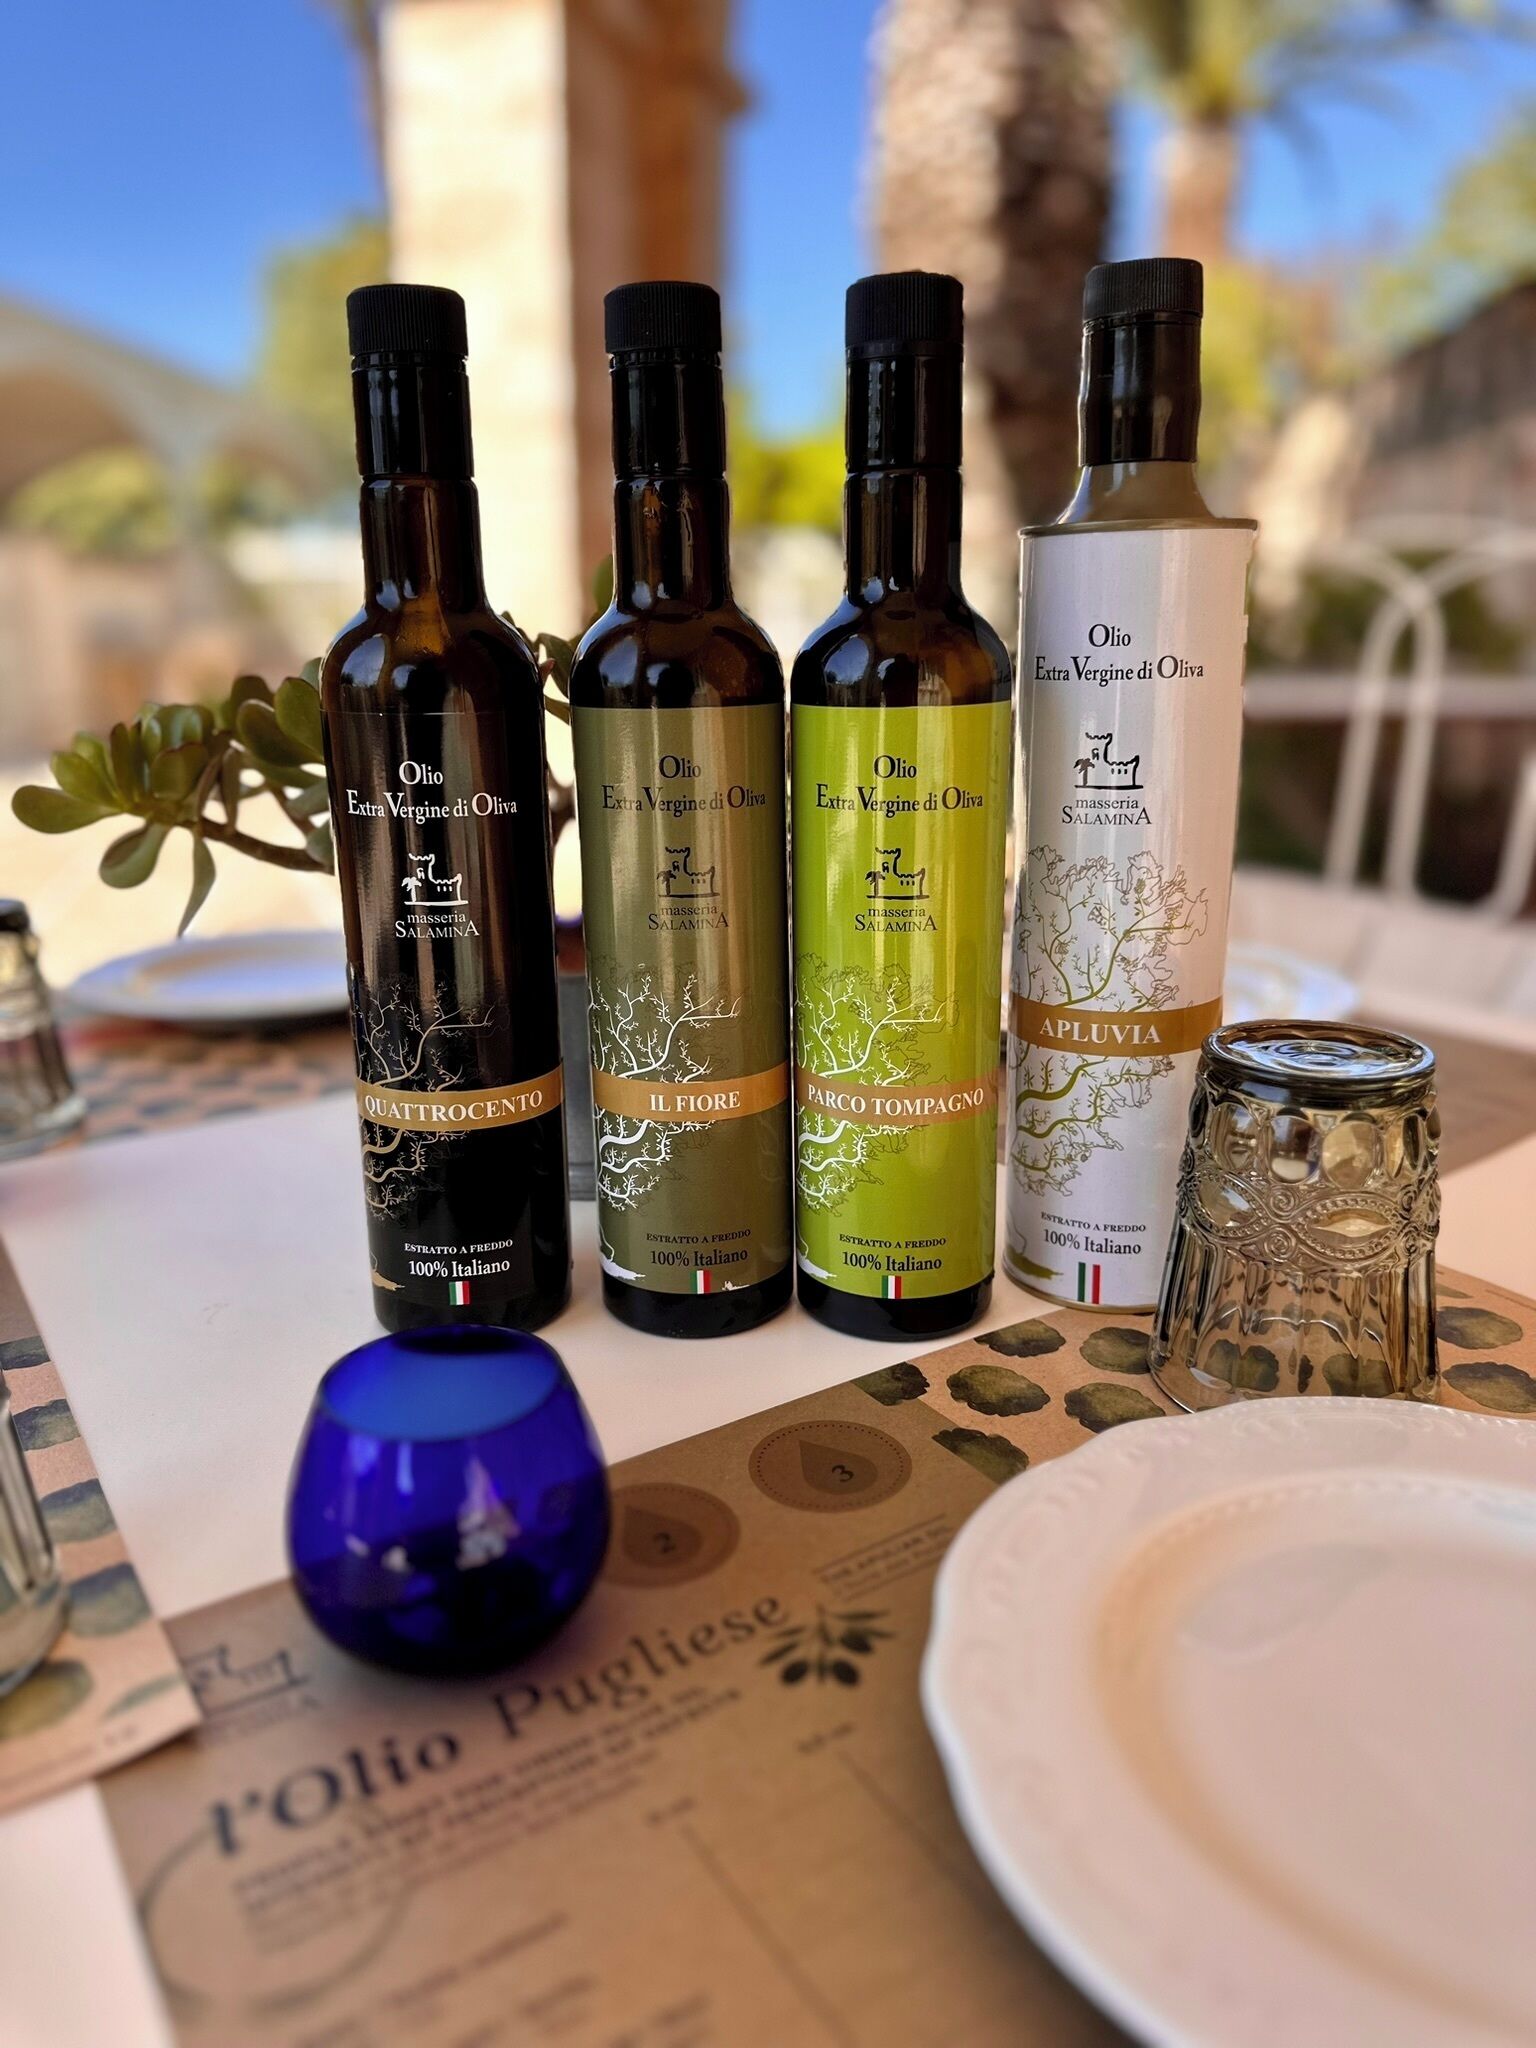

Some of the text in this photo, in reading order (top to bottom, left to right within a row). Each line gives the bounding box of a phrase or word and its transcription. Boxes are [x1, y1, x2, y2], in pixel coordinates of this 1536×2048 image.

[1088, 623, 1131, 647] Olio
[1034, 655, 1204, 687] Extra Vergine di Oliva
[399, 761, 444, 785] Olio
[659, 755, 702, 779] Olio
[874, 755, 917, 778] Olio
[346, 788, 517, 824] Extra Vergine di Oliva
[601, 784, 766, 817] Extra Vergine di Oliva
[816, 783, 984, 818] Extra Vergine di Oliva
[1076, 796, 1139, 809] masseria
[1062, 805, 1152, 826] SALAMINA
[407, 911, 466, 923] masseria
[660, 903, 718, 916] masseria
[868, 906, 926, 917] masseria
[395, 920, 480, 938] SALAMINA
[648, 912, 729, 931] SALAMINA
[855, 913, 938, 932] SALAMINA
[1039, 1017, 1163, 1044] APLUVIA
[364, 1089, 543, 1122] QUATTROCENTO
[650, 1091, 741, 1113] IL FIORE
[807, 1084, 984, 1116] PARCO TOMPAGNO
[1040, 1211, 1147, 1232] ESTRATTO A FREDDO
[646, 1228, 751, 1244] ESTRATTO A FREDDO
[839, 1233, 947, 1249] ESTRATTO A FREDDO
[1043, 1228, 1142, 1255] 100% Italiano
[404, 1239, 513, 1255] ESTRATTO A FREDDO
[408, 1259, 511, 1278] 100% Italiano
[651, 1249, 748, 1267] 100% Italiano
[842, 1251, 942, 1272] 100% Italiano
[831, 1464, 855, 1483] 3
[492, 1594, 792, 1741] Pugliese
